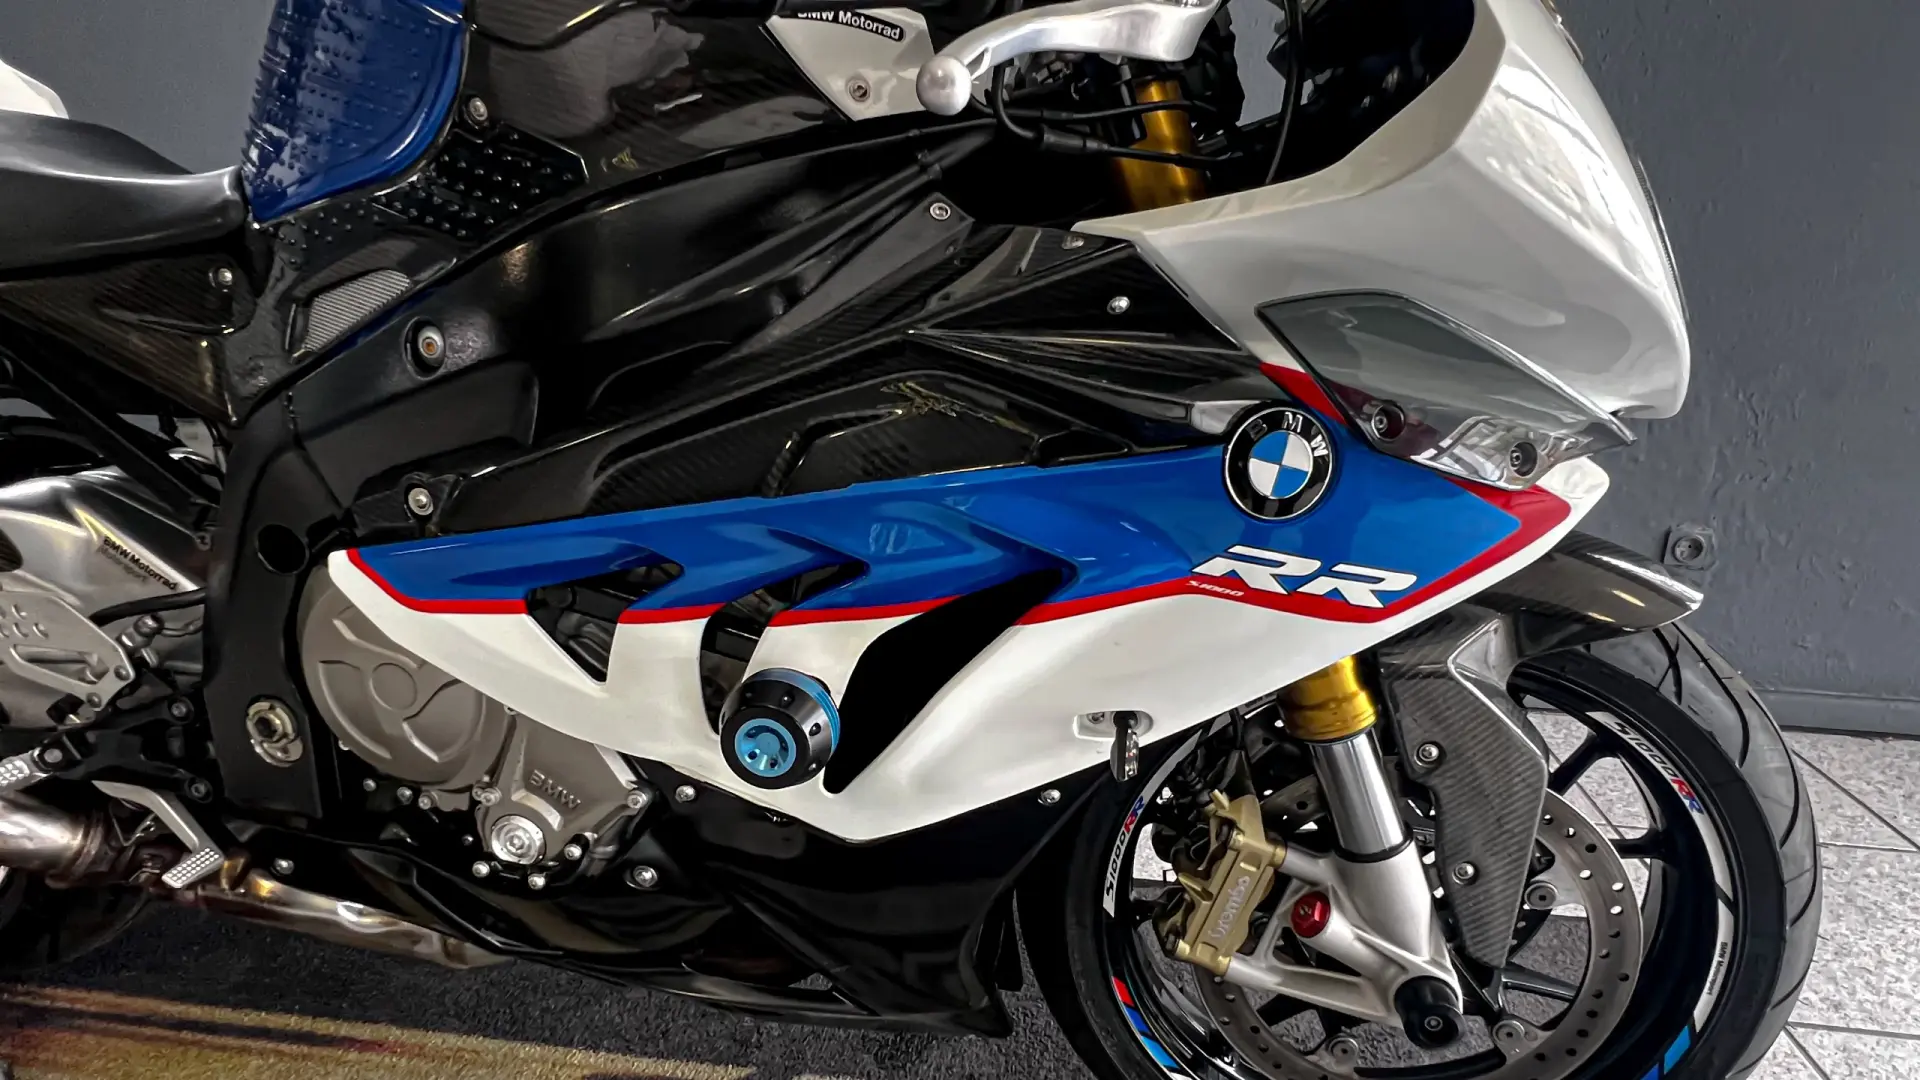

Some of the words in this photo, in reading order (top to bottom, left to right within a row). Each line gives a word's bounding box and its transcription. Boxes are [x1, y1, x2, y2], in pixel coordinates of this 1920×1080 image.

[839, 10, 900, 40] Motorrad
[1245, 411, 1329, 458] BMW
[103, 535, 132, 558] BMW
[129, 554, 178, 590] Motorrad
[1191, 544, 1418, 609] RR
[1185, 580, 1245, 597] S1000
[529, 769, 581, 809] BMW
[1604, 721, 1705, 816] S1000RR
[1106, 795, 1145, 903] S1000RR
